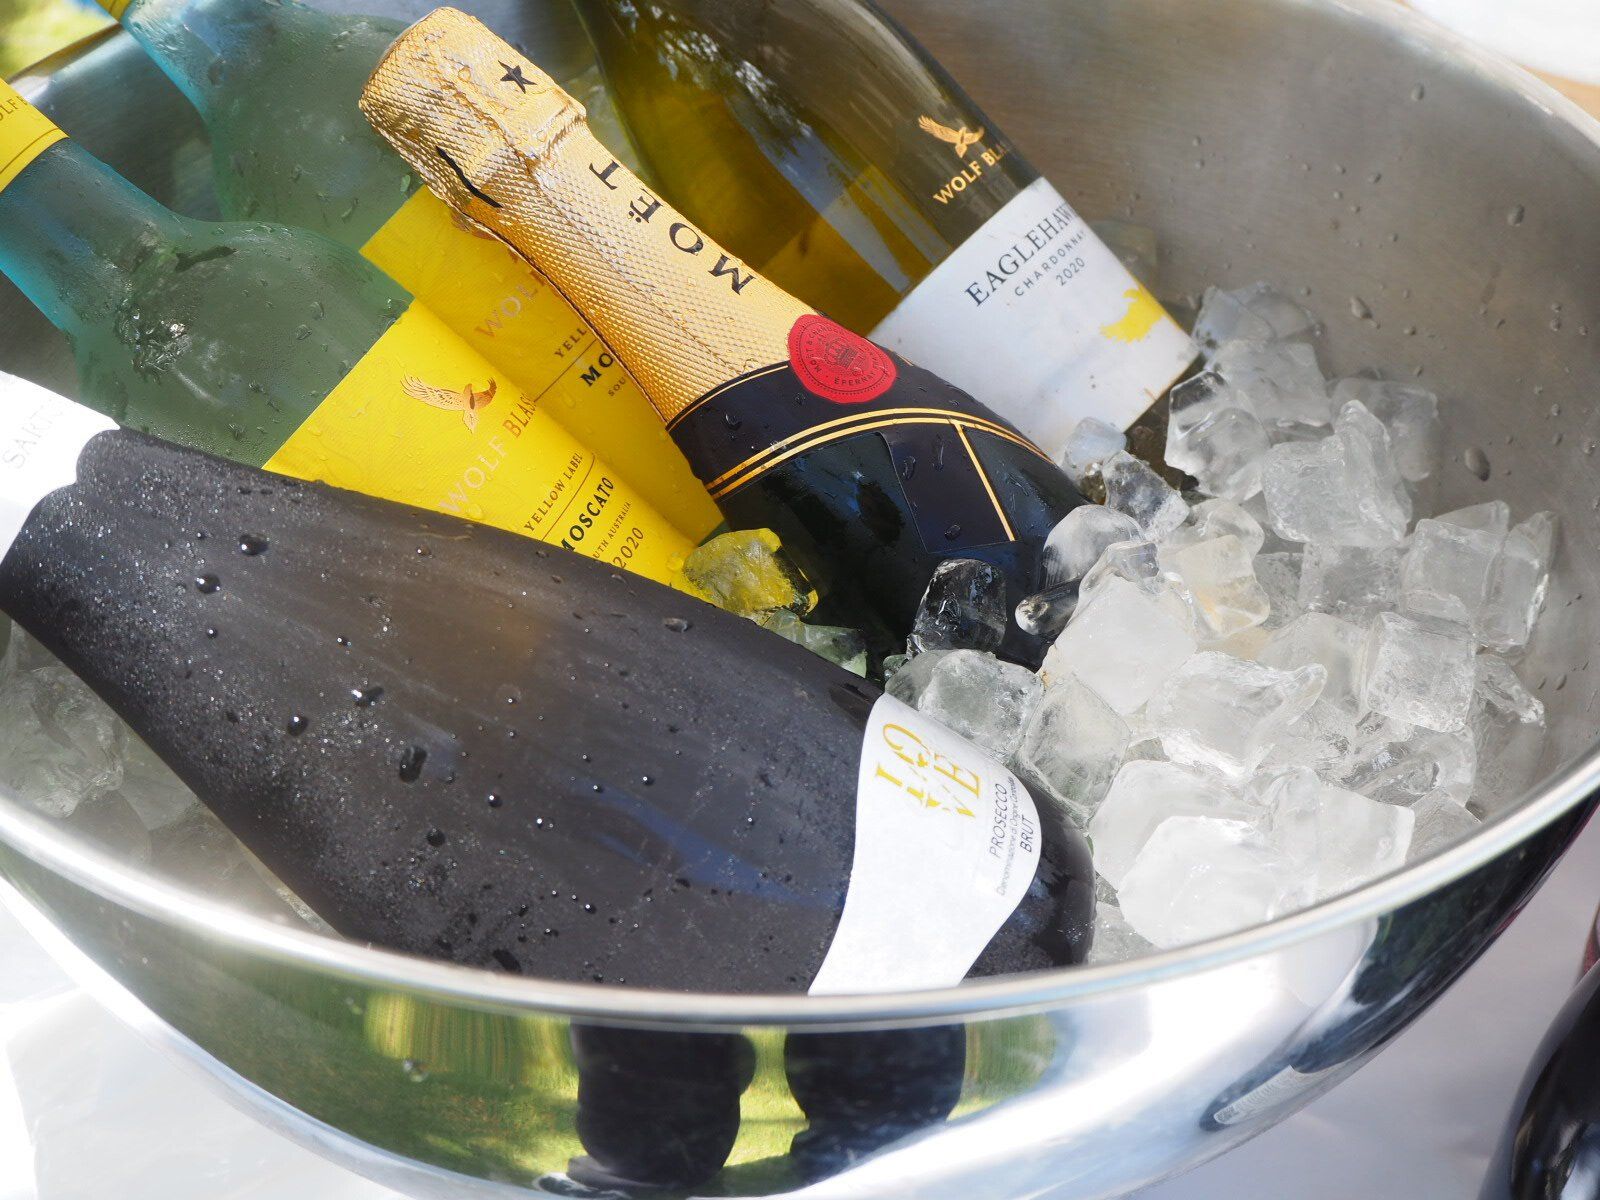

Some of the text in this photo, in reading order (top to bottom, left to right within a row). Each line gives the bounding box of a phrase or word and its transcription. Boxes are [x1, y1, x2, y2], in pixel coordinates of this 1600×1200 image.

[933, 160, 982, 205] WOLF
[589, 160, 756, 295] MOËT
[1056, 257, 1085, 286] 2020
[438, 434, 508, 513] WOLF
[523, 452, 583, 532] YELLOW LABEL
[591, 501, 632, 561] UTH AUSTRALIA
[612, 526, 645, 568] 2020
[989, 783, 1008, 859] PROSECCO
[1019, 814, 1034, 853] BRUT
